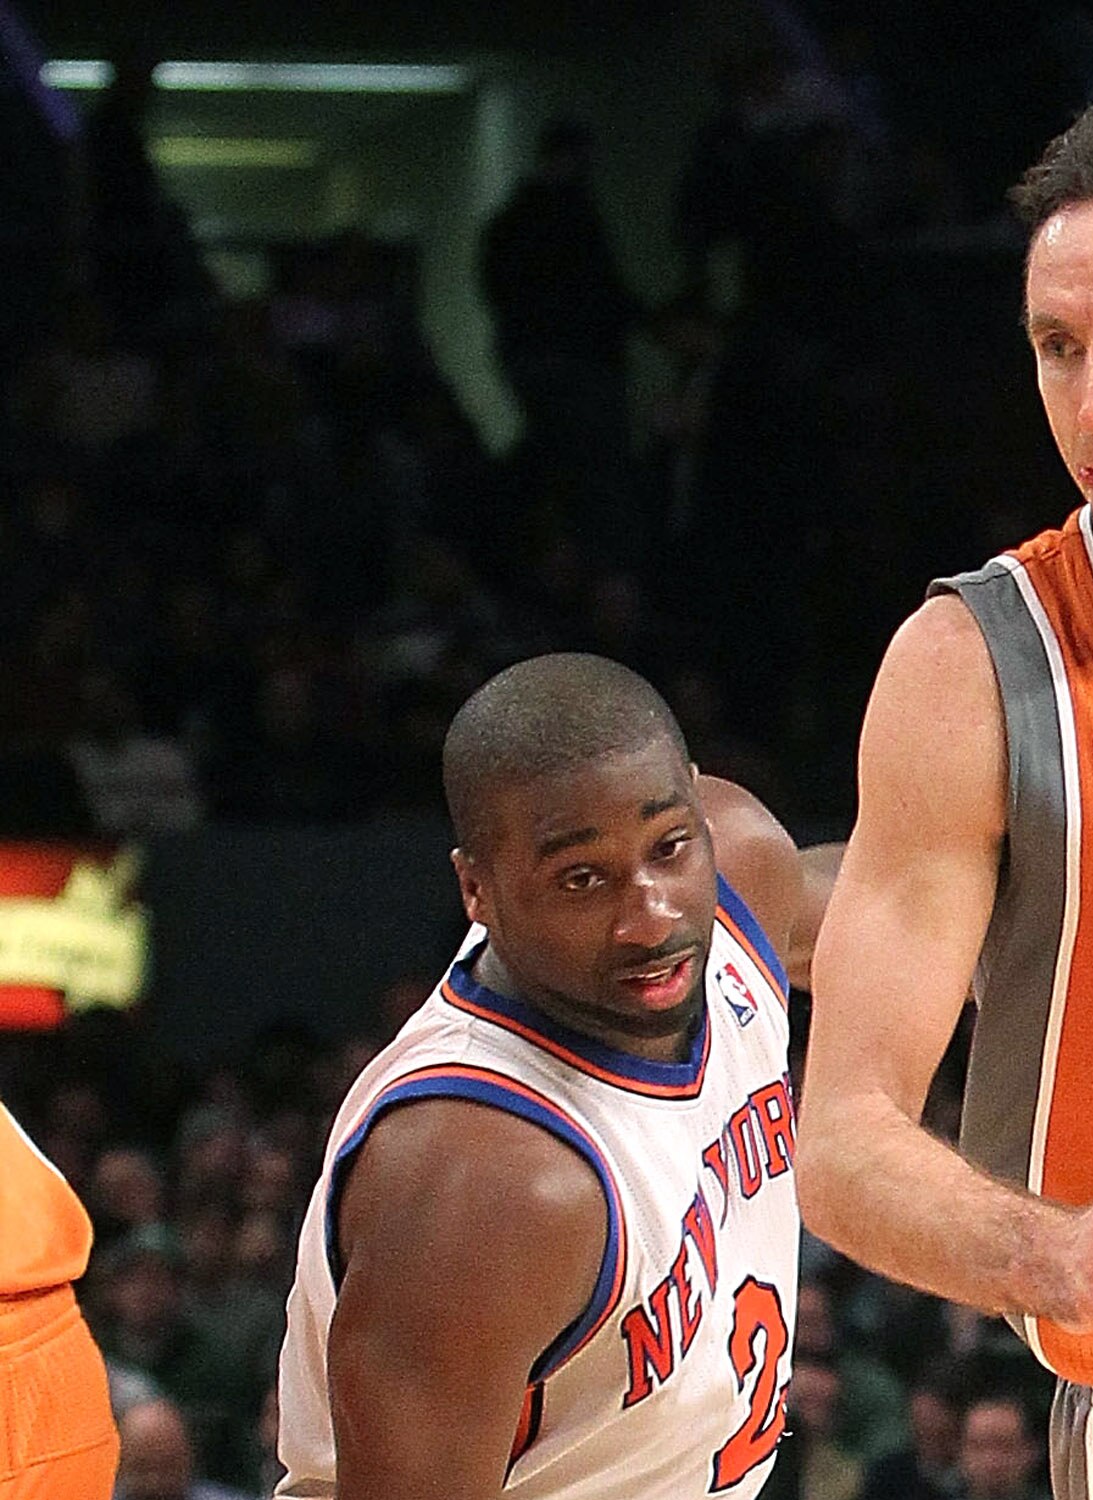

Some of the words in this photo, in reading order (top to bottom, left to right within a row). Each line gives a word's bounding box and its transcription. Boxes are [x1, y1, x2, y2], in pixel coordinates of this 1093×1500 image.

[620, 1180, 719, 1411] NEW
[702, 1071, 797, 1231] YOR
[708, 1273, 792, 1494] 2
